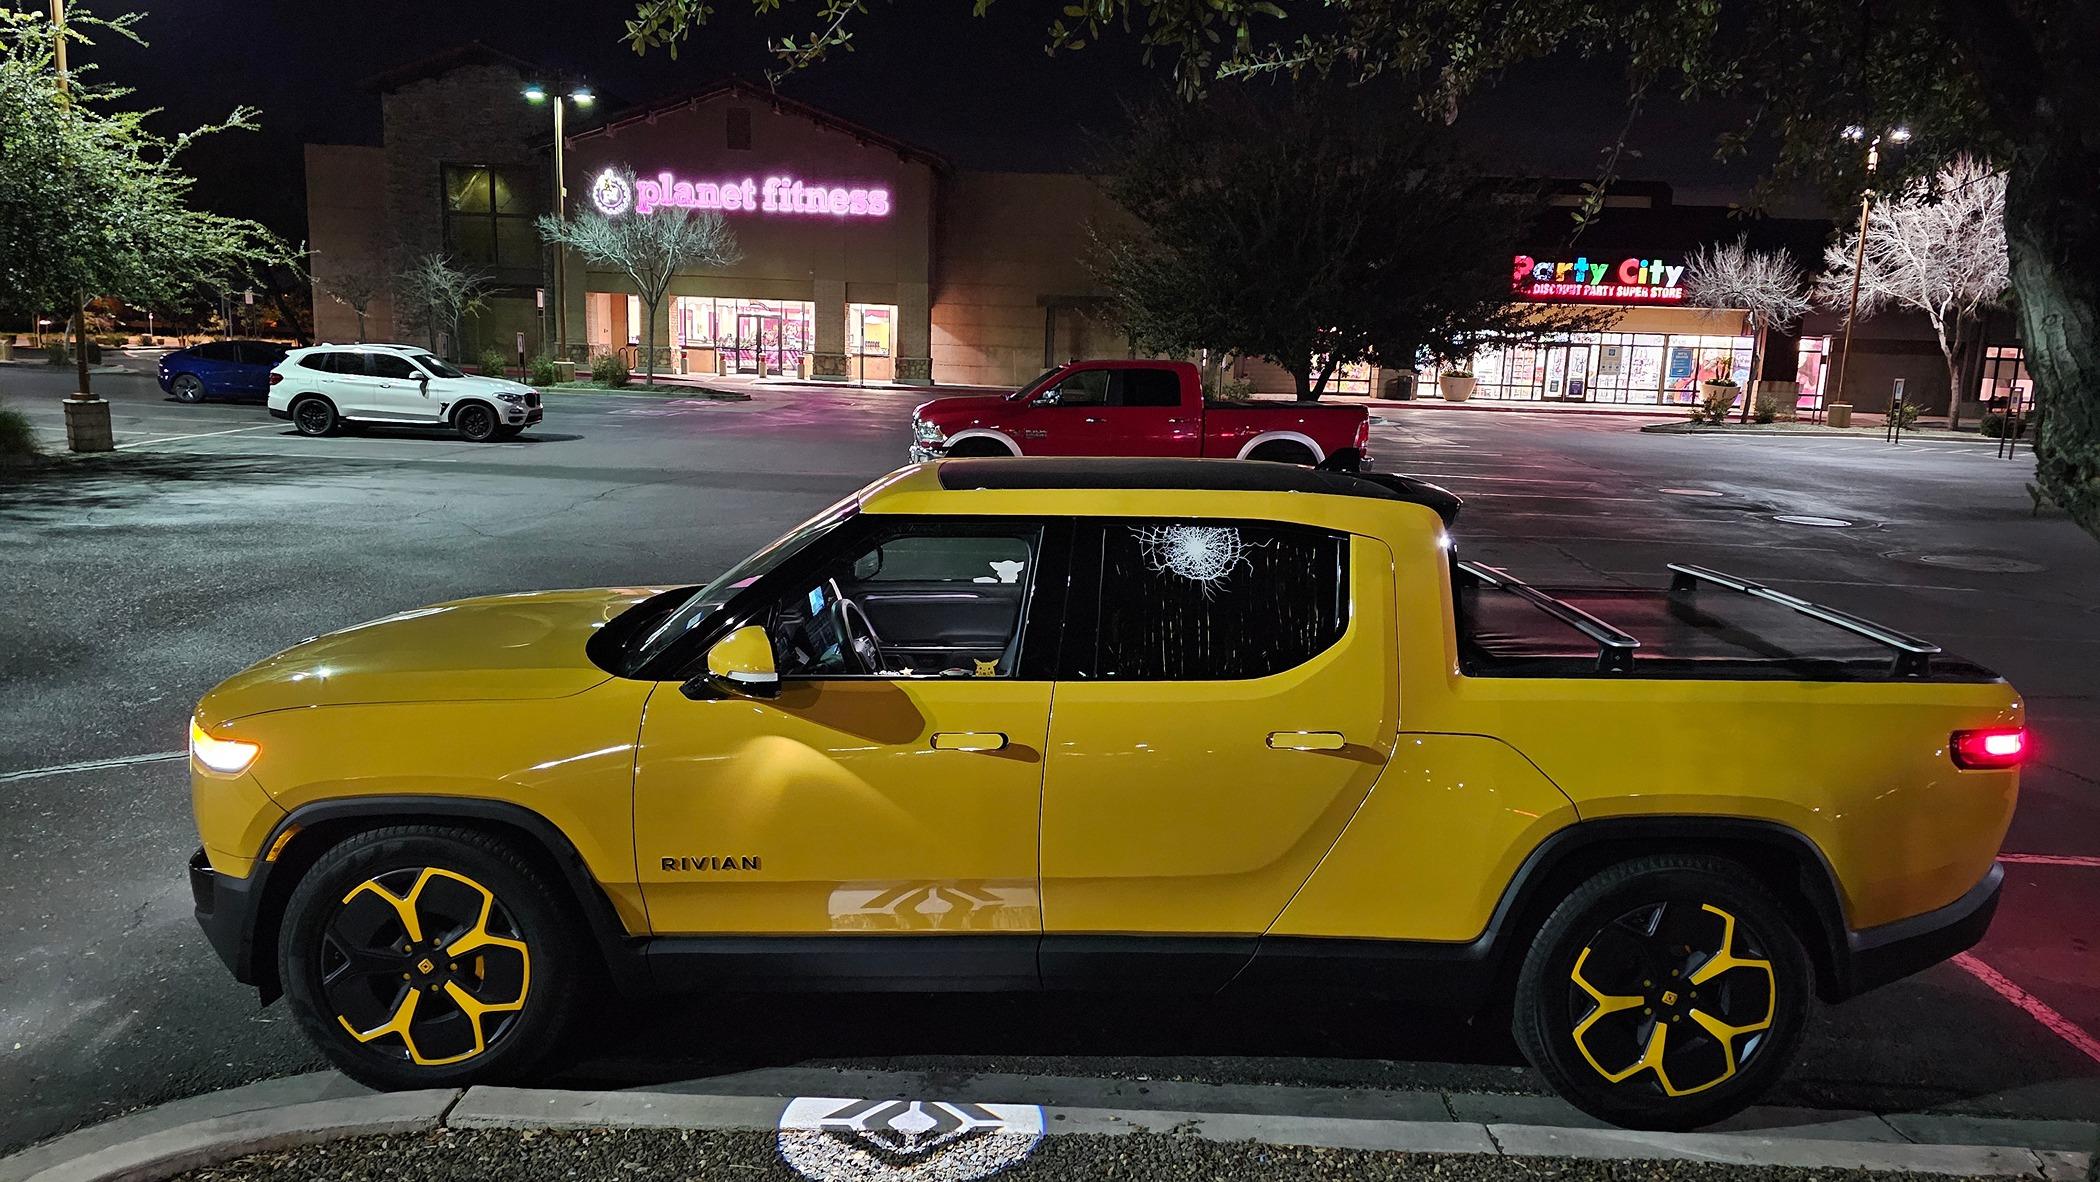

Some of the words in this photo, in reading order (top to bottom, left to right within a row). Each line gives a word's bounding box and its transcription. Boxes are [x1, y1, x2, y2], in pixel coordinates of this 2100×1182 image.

[635, 172, 756, 214] planet
[762, 177, 890, 215] fitness
[1513, 255, 1609, 285] Party
[1618, 258, 1685, 287] City
[1583, 284, 1615, 297] PARTY
[1616, 285, 1649, 298] SUPER
[1650, 286, 1683, 299] STORE
[661, 855, 761, 872] RIVIAN
